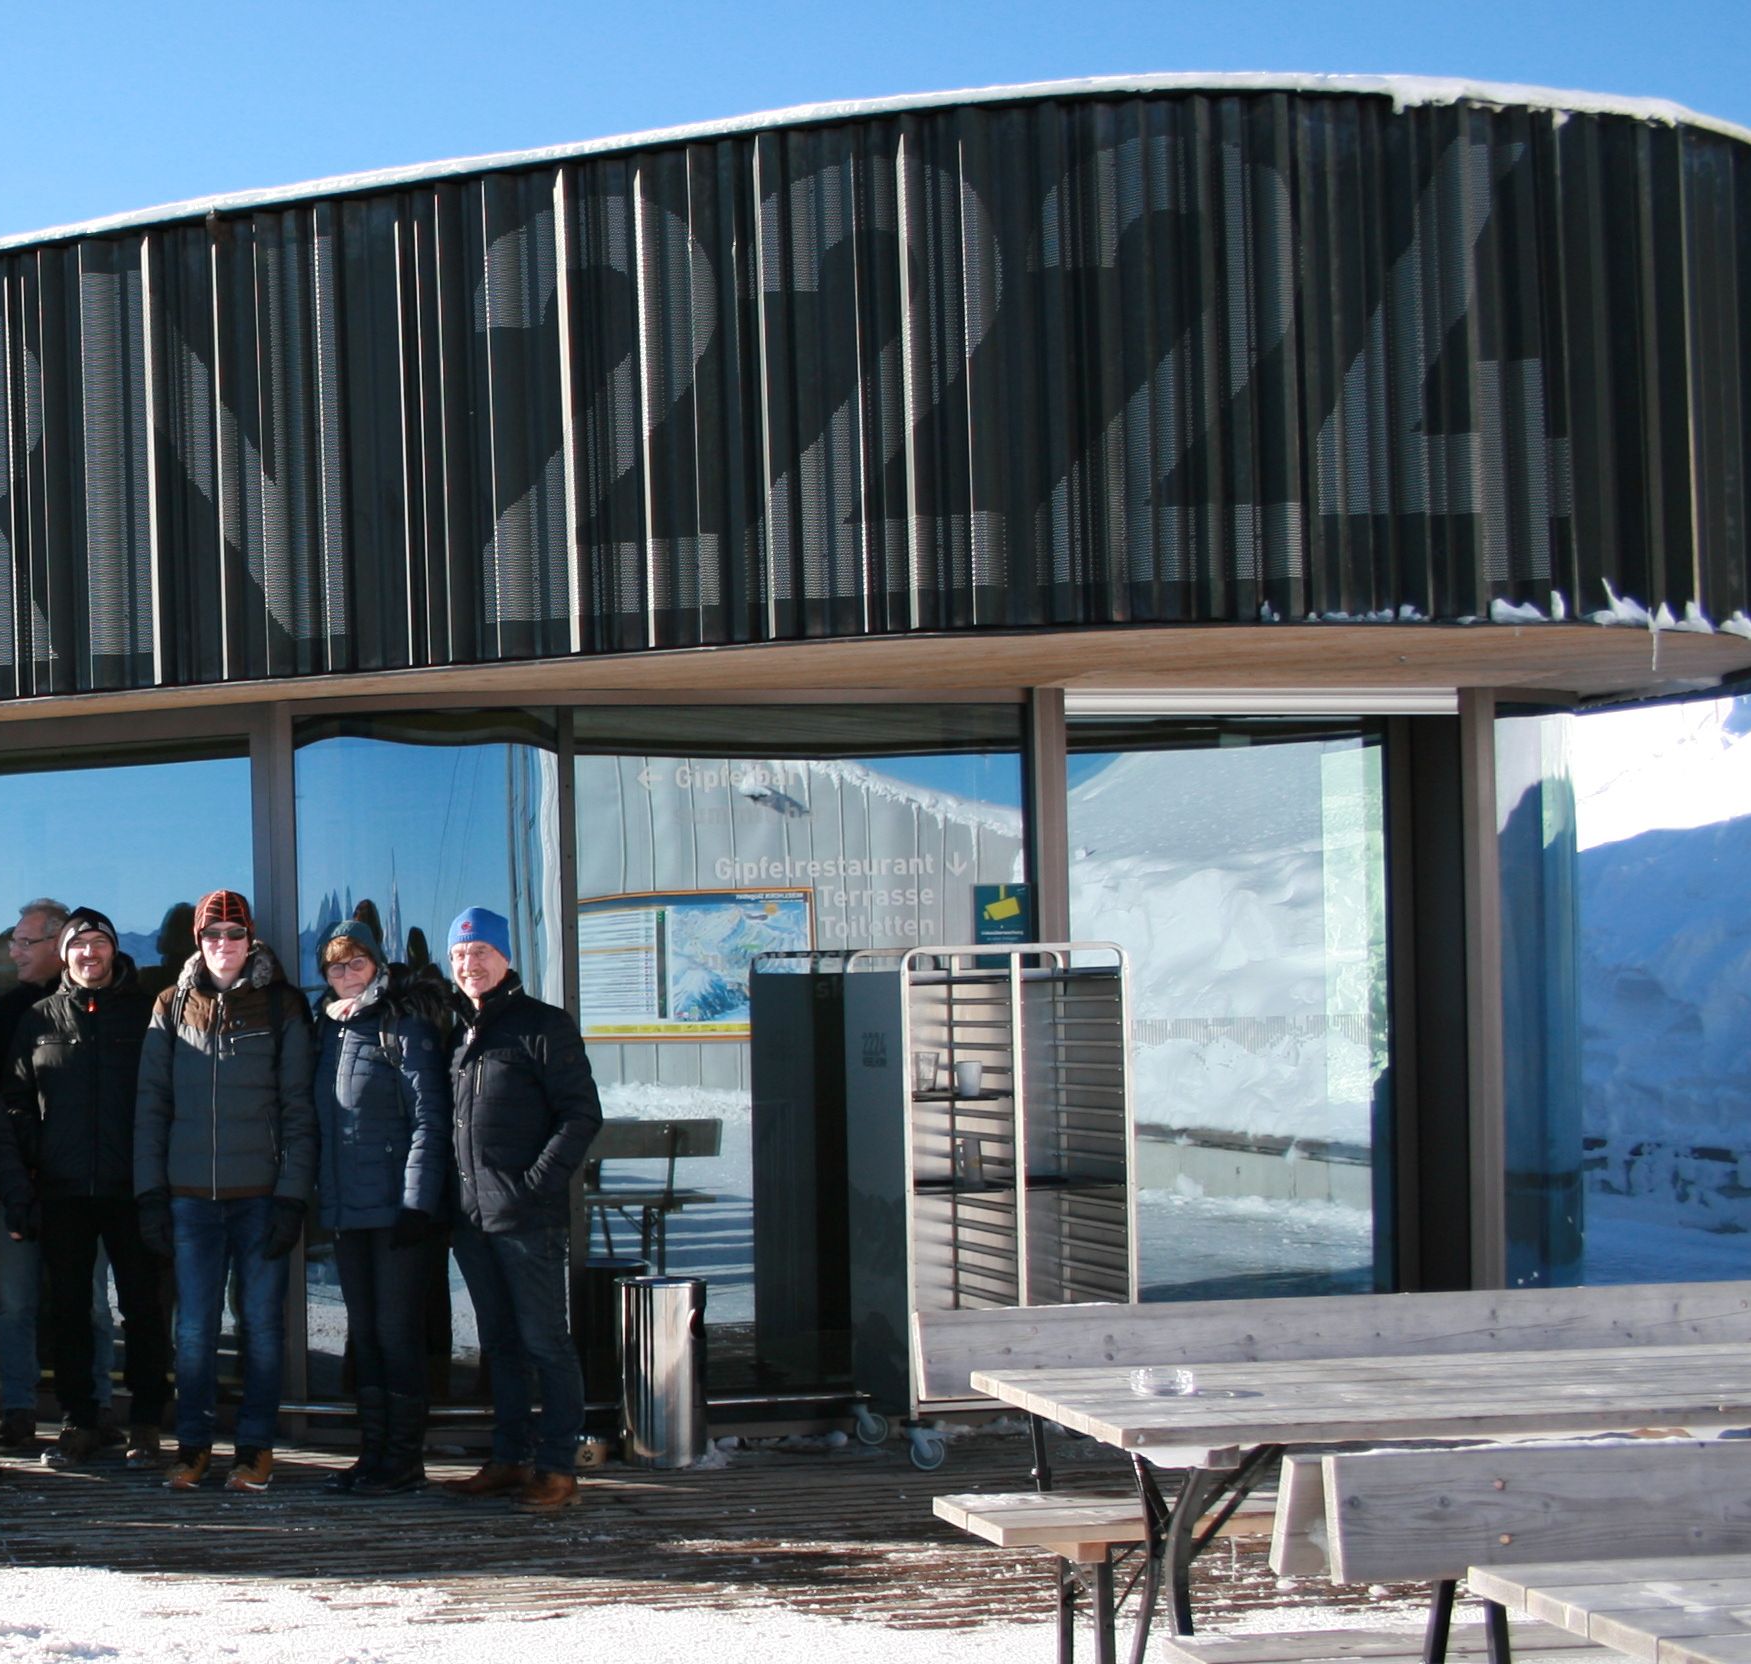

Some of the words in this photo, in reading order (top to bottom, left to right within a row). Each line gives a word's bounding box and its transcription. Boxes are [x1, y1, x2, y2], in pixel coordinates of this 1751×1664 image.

[474, 136, 1573, 624] 2224
[675, 764, 798, 793] Gipfelbar
[714, 854, 935, 884] Gipfelrestaurant
[819, 885, 934, 908] Terrasse
[819, 915, 935, 938] Toiletten
